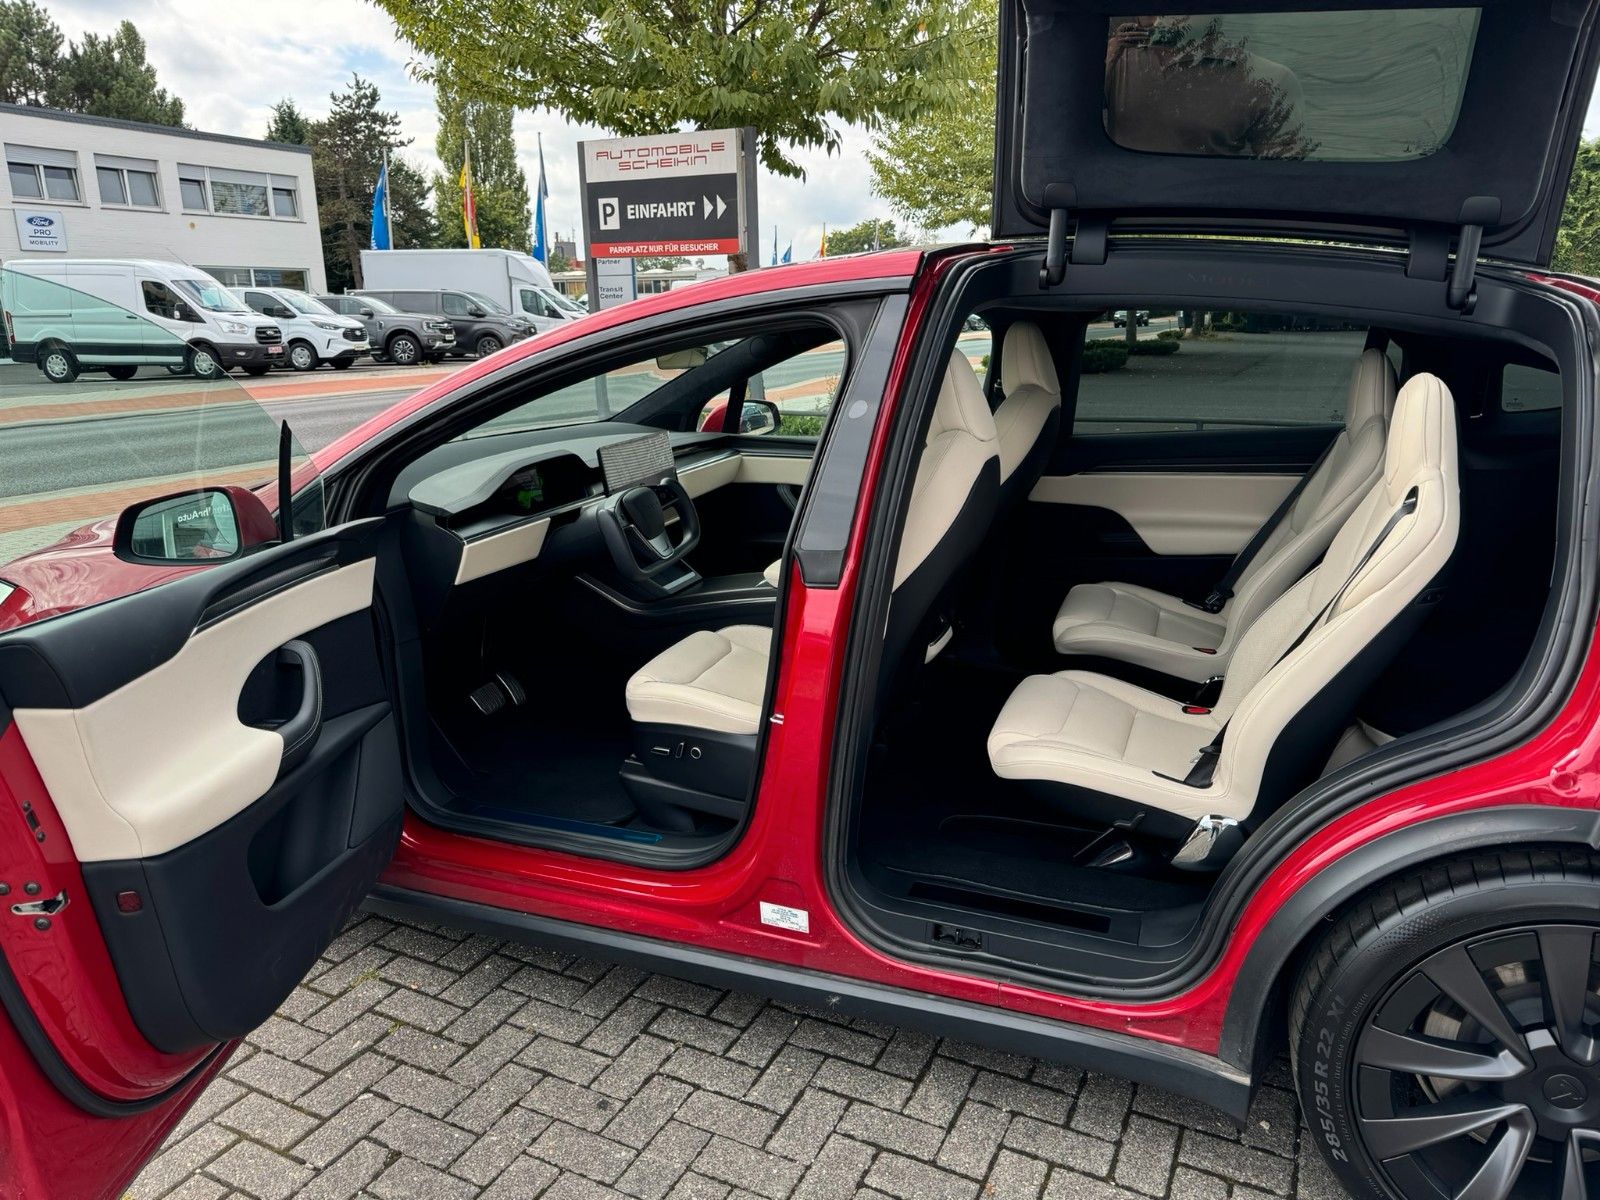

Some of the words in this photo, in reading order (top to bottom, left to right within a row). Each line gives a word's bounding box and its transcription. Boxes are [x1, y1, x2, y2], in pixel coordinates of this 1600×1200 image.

[596, 142, 724, 160] AUTOMOBILE
[603, 203, 615, 225] P
[627, 202, 695, 219] EINFAHRT
[609, 245, 648, 253] PARKPLATZ
[649, 244, 664, 252] NUR
[665, 243, 679, 252] FÜR
[680, 243, 718, 251] BESUCHER
[1317, 1028, 1335, 1059] 22
